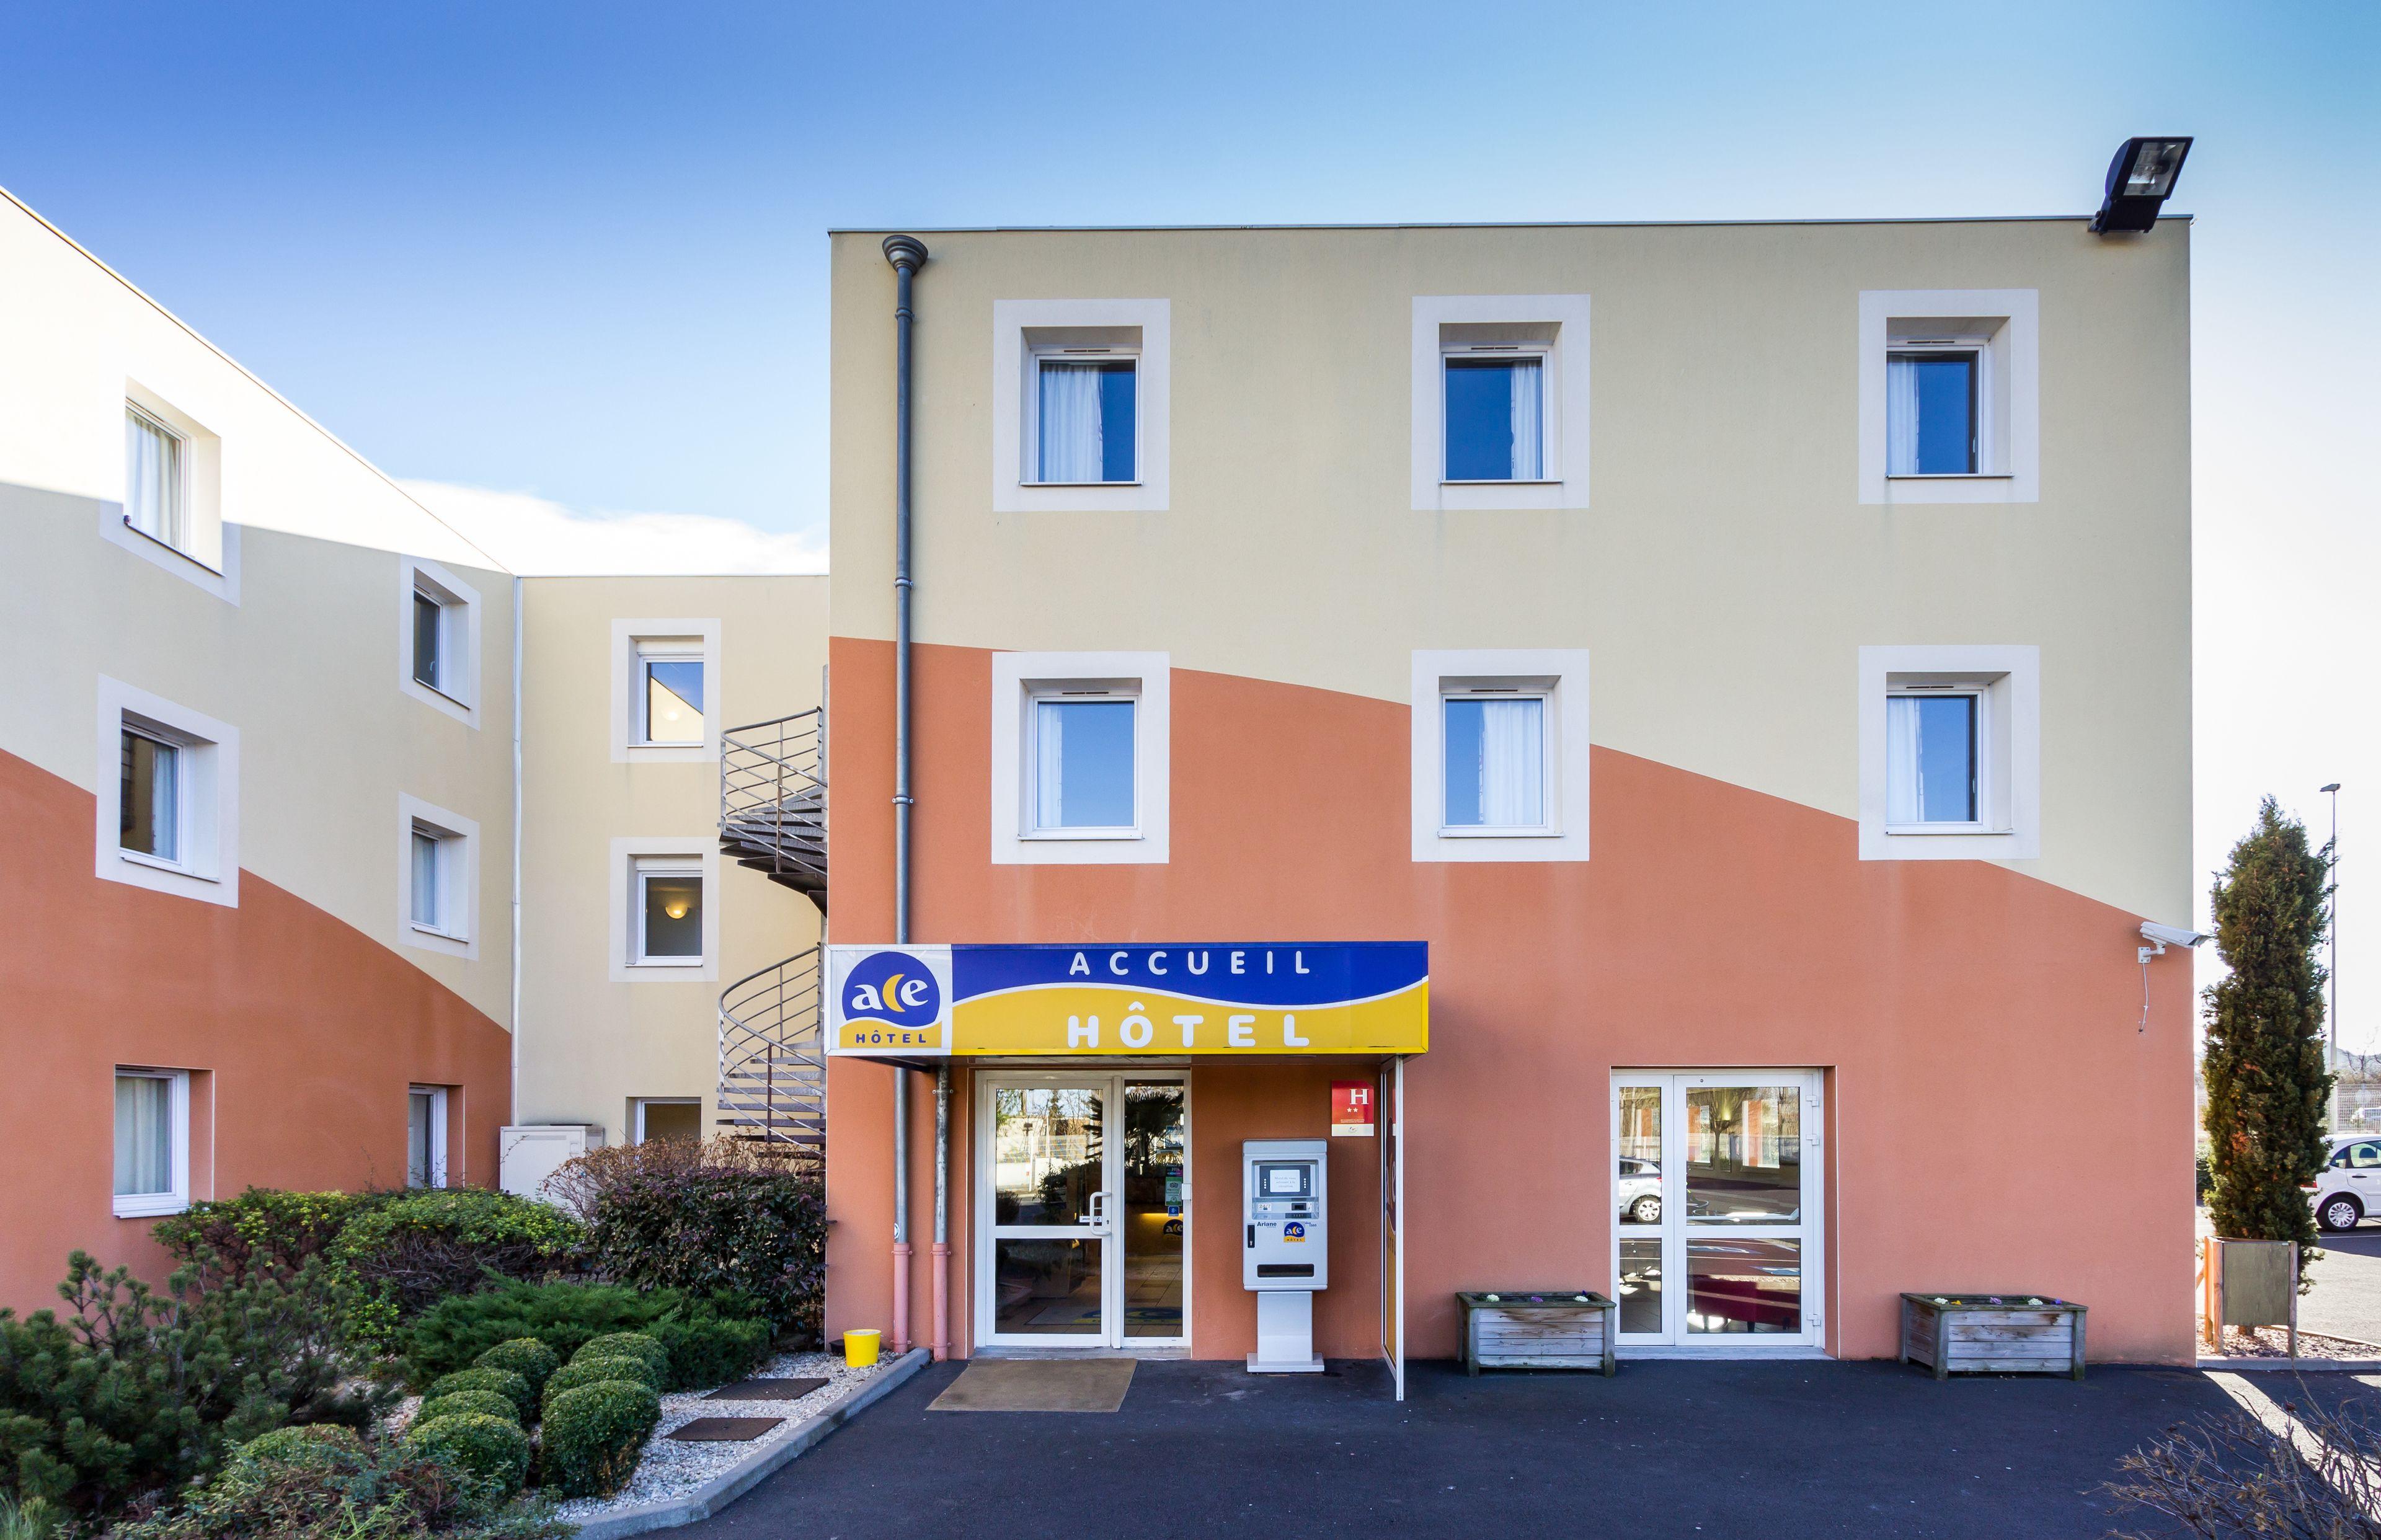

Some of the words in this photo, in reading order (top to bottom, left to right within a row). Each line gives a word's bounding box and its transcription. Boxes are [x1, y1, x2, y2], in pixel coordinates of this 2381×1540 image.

[1069, 950, 1310, 976] ACCUEIL
[851, 973, 929, 1012] ace
[1067, 1001, 1310, 1048] HÔTEL
[855, 1029, 926, 1043] HÔTEL
[1349, 1088, 1369, 1105] H
[1286, 1226, 1302, 1235] ace
